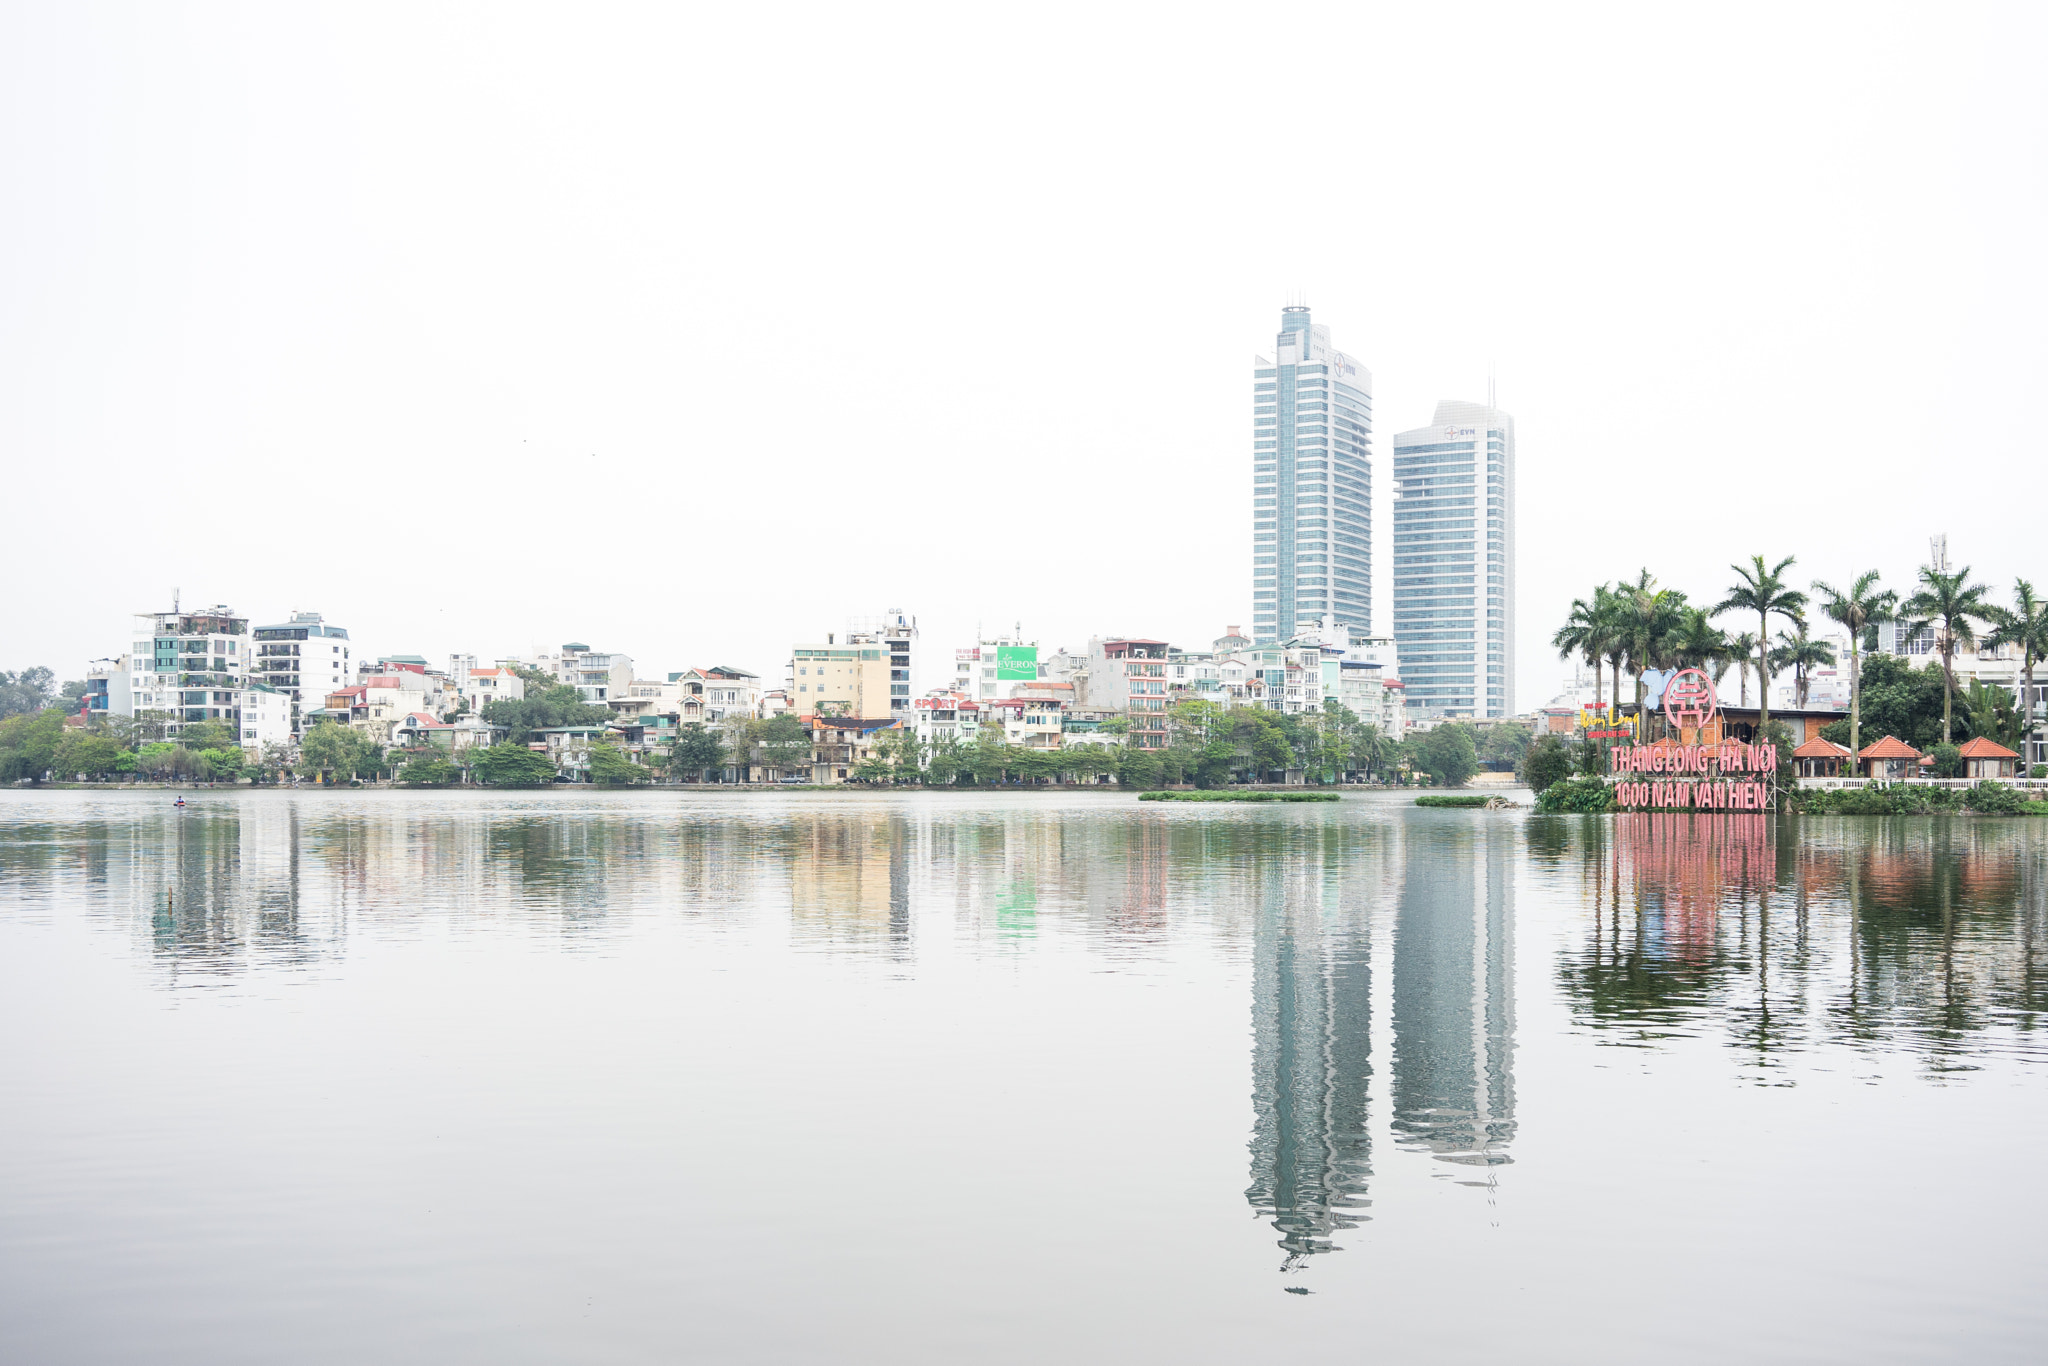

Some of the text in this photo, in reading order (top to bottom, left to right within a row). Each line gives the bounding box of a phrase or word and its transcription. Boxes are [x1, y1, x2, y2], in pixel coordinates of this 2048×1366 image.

[1460, 428, 1475, 436] EVN
[998, 660, 1037, 669] EVERON
[1610, 739, 1663, 772] THĂNG
[1665, 745, 1709, 772] LONG
[1615, 781, 1649, 807] 1000
[1651, 775, 1690, 808] NĂM
[1693, 775, 1725, 808] VĂN
